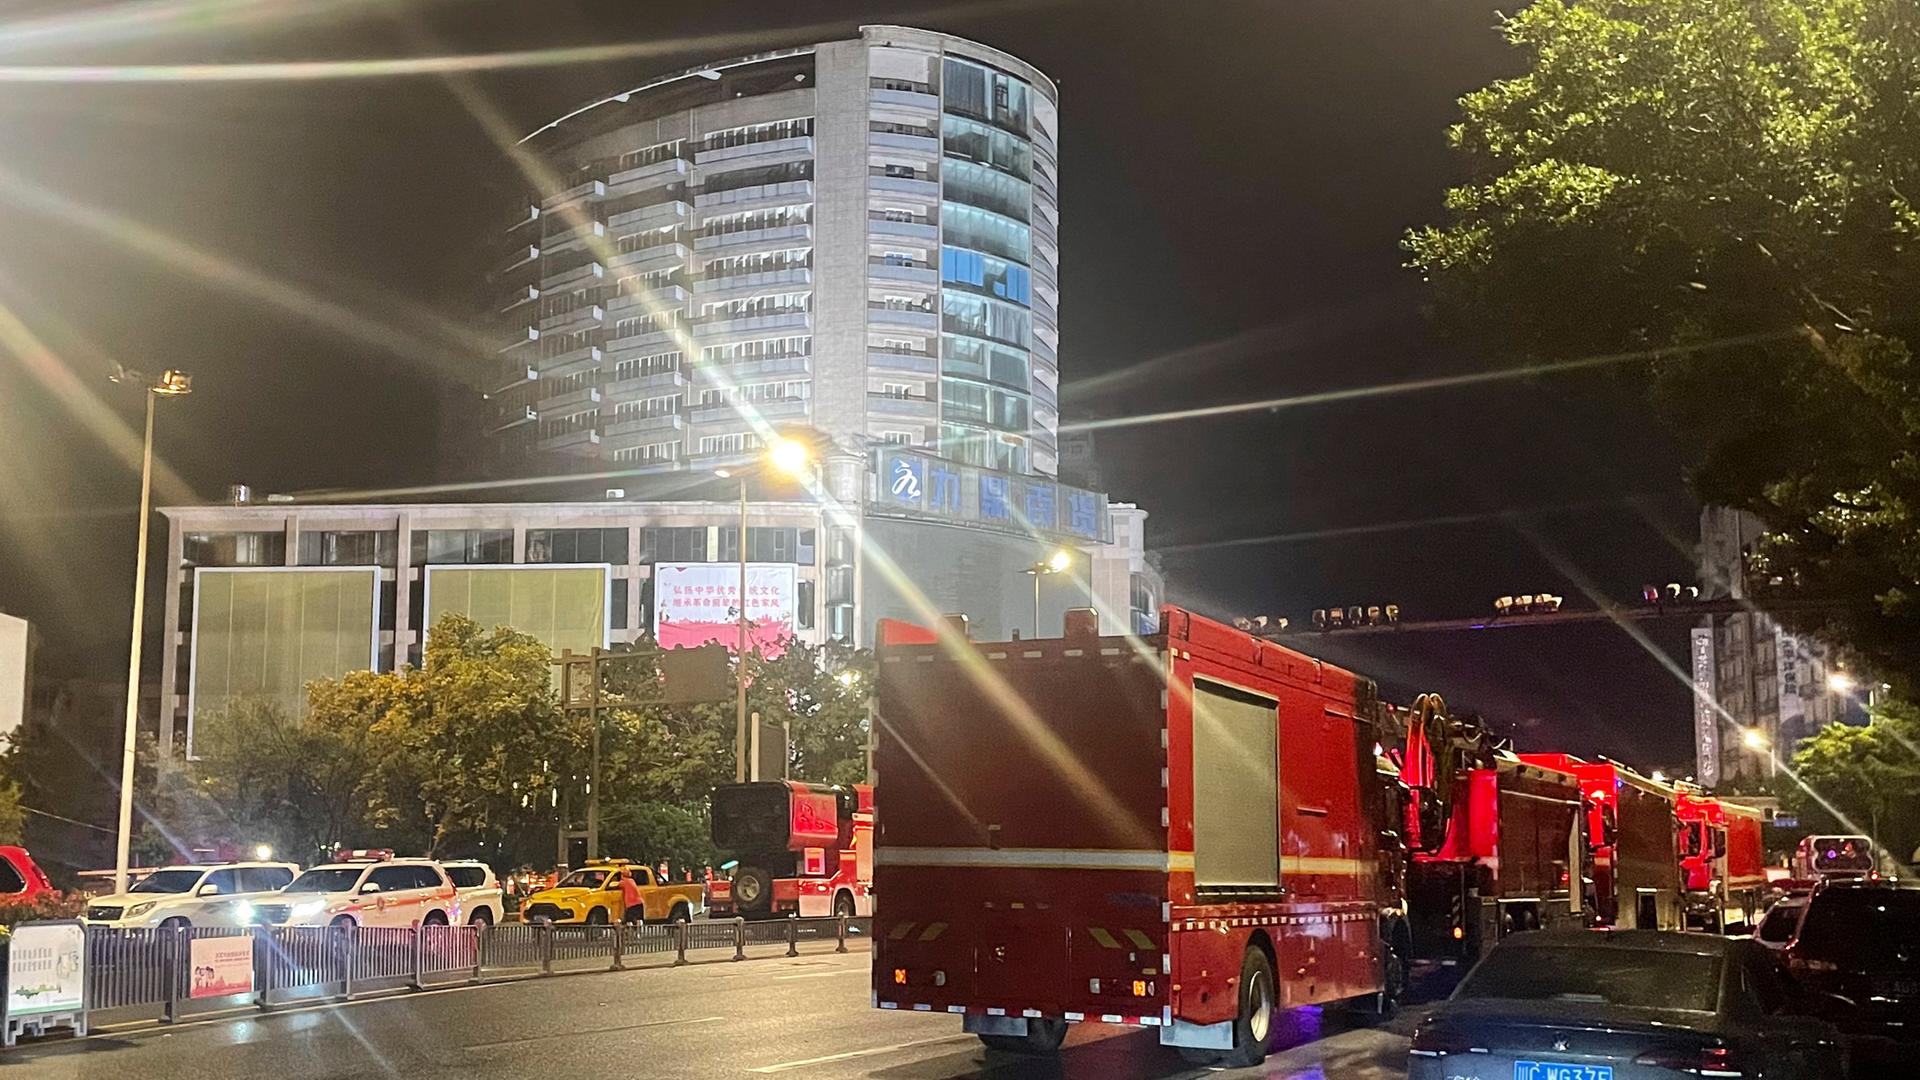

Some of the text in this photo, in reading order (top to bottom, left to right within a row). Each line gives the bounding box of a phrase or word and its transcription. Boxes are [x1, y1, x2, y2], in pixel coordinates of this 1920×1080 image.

[674, 585, 780, 595] 弘扬中华优秀统文化
